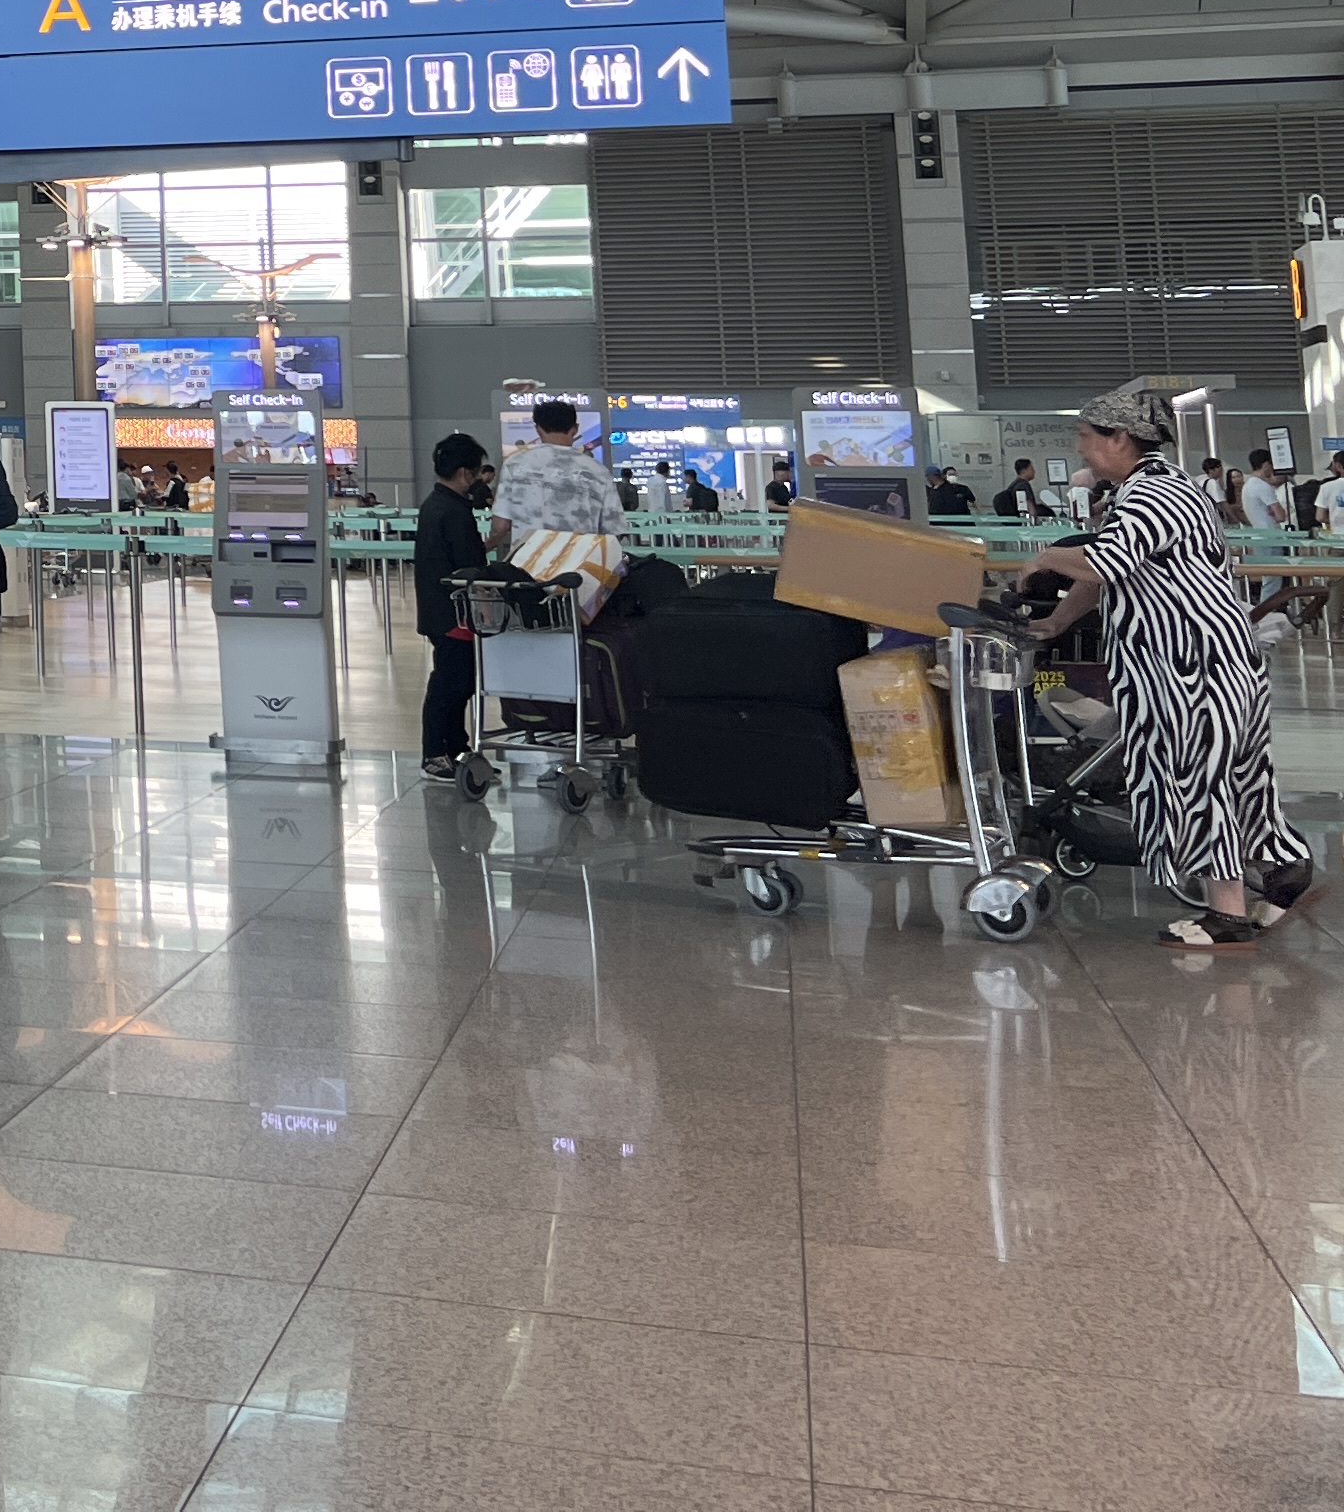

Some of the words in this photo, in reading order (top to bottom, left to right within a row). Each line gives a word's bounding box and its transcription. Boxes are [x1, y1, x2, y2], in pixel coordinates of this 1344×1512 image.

[229, 394, 250, 406] Self
[252, 394, 304, 406] Check-In
[509, 392, 533, 405] Self
[812, 391, 837, 404] Self
[839, 391, 899, 405] Check-In
[1004, 421, 1022, 433] All
[1026, 423, 1064, 436] gates
[1004, 438, 1034, 448] Gate
[1033, 670, 1066, 682] 2025
